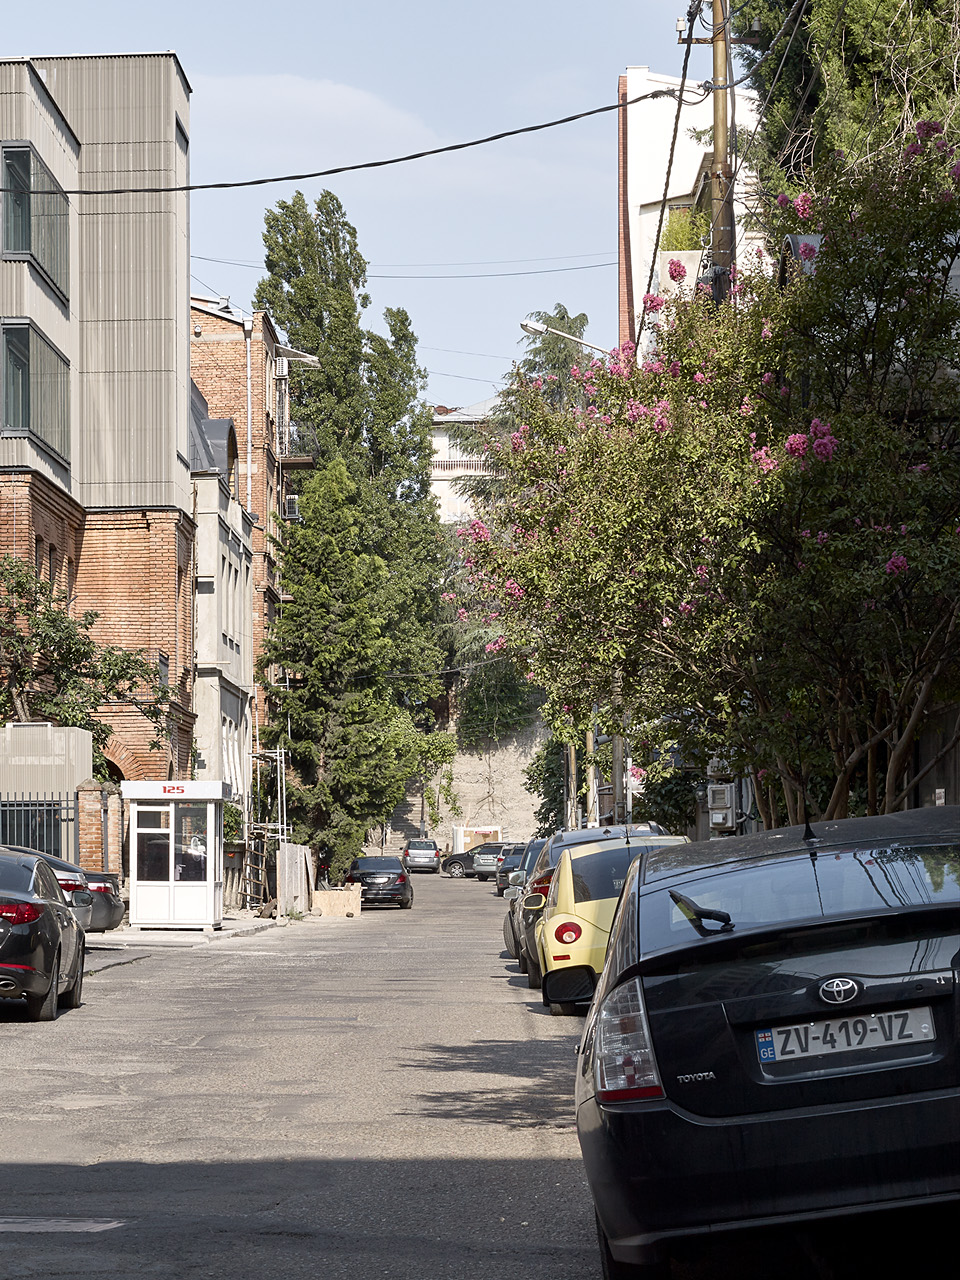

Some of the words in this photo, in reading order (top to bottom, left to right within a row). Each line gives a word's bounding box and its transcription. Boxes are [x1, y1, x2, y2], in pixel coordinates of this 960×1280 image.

[162, 785, 185, 794] 125
[776, 1012, 913, 1057] ZV-419-VZ
[760, 1047, 775, 1059] GE
[676, 1071, 717, 1084] TOYOTA
